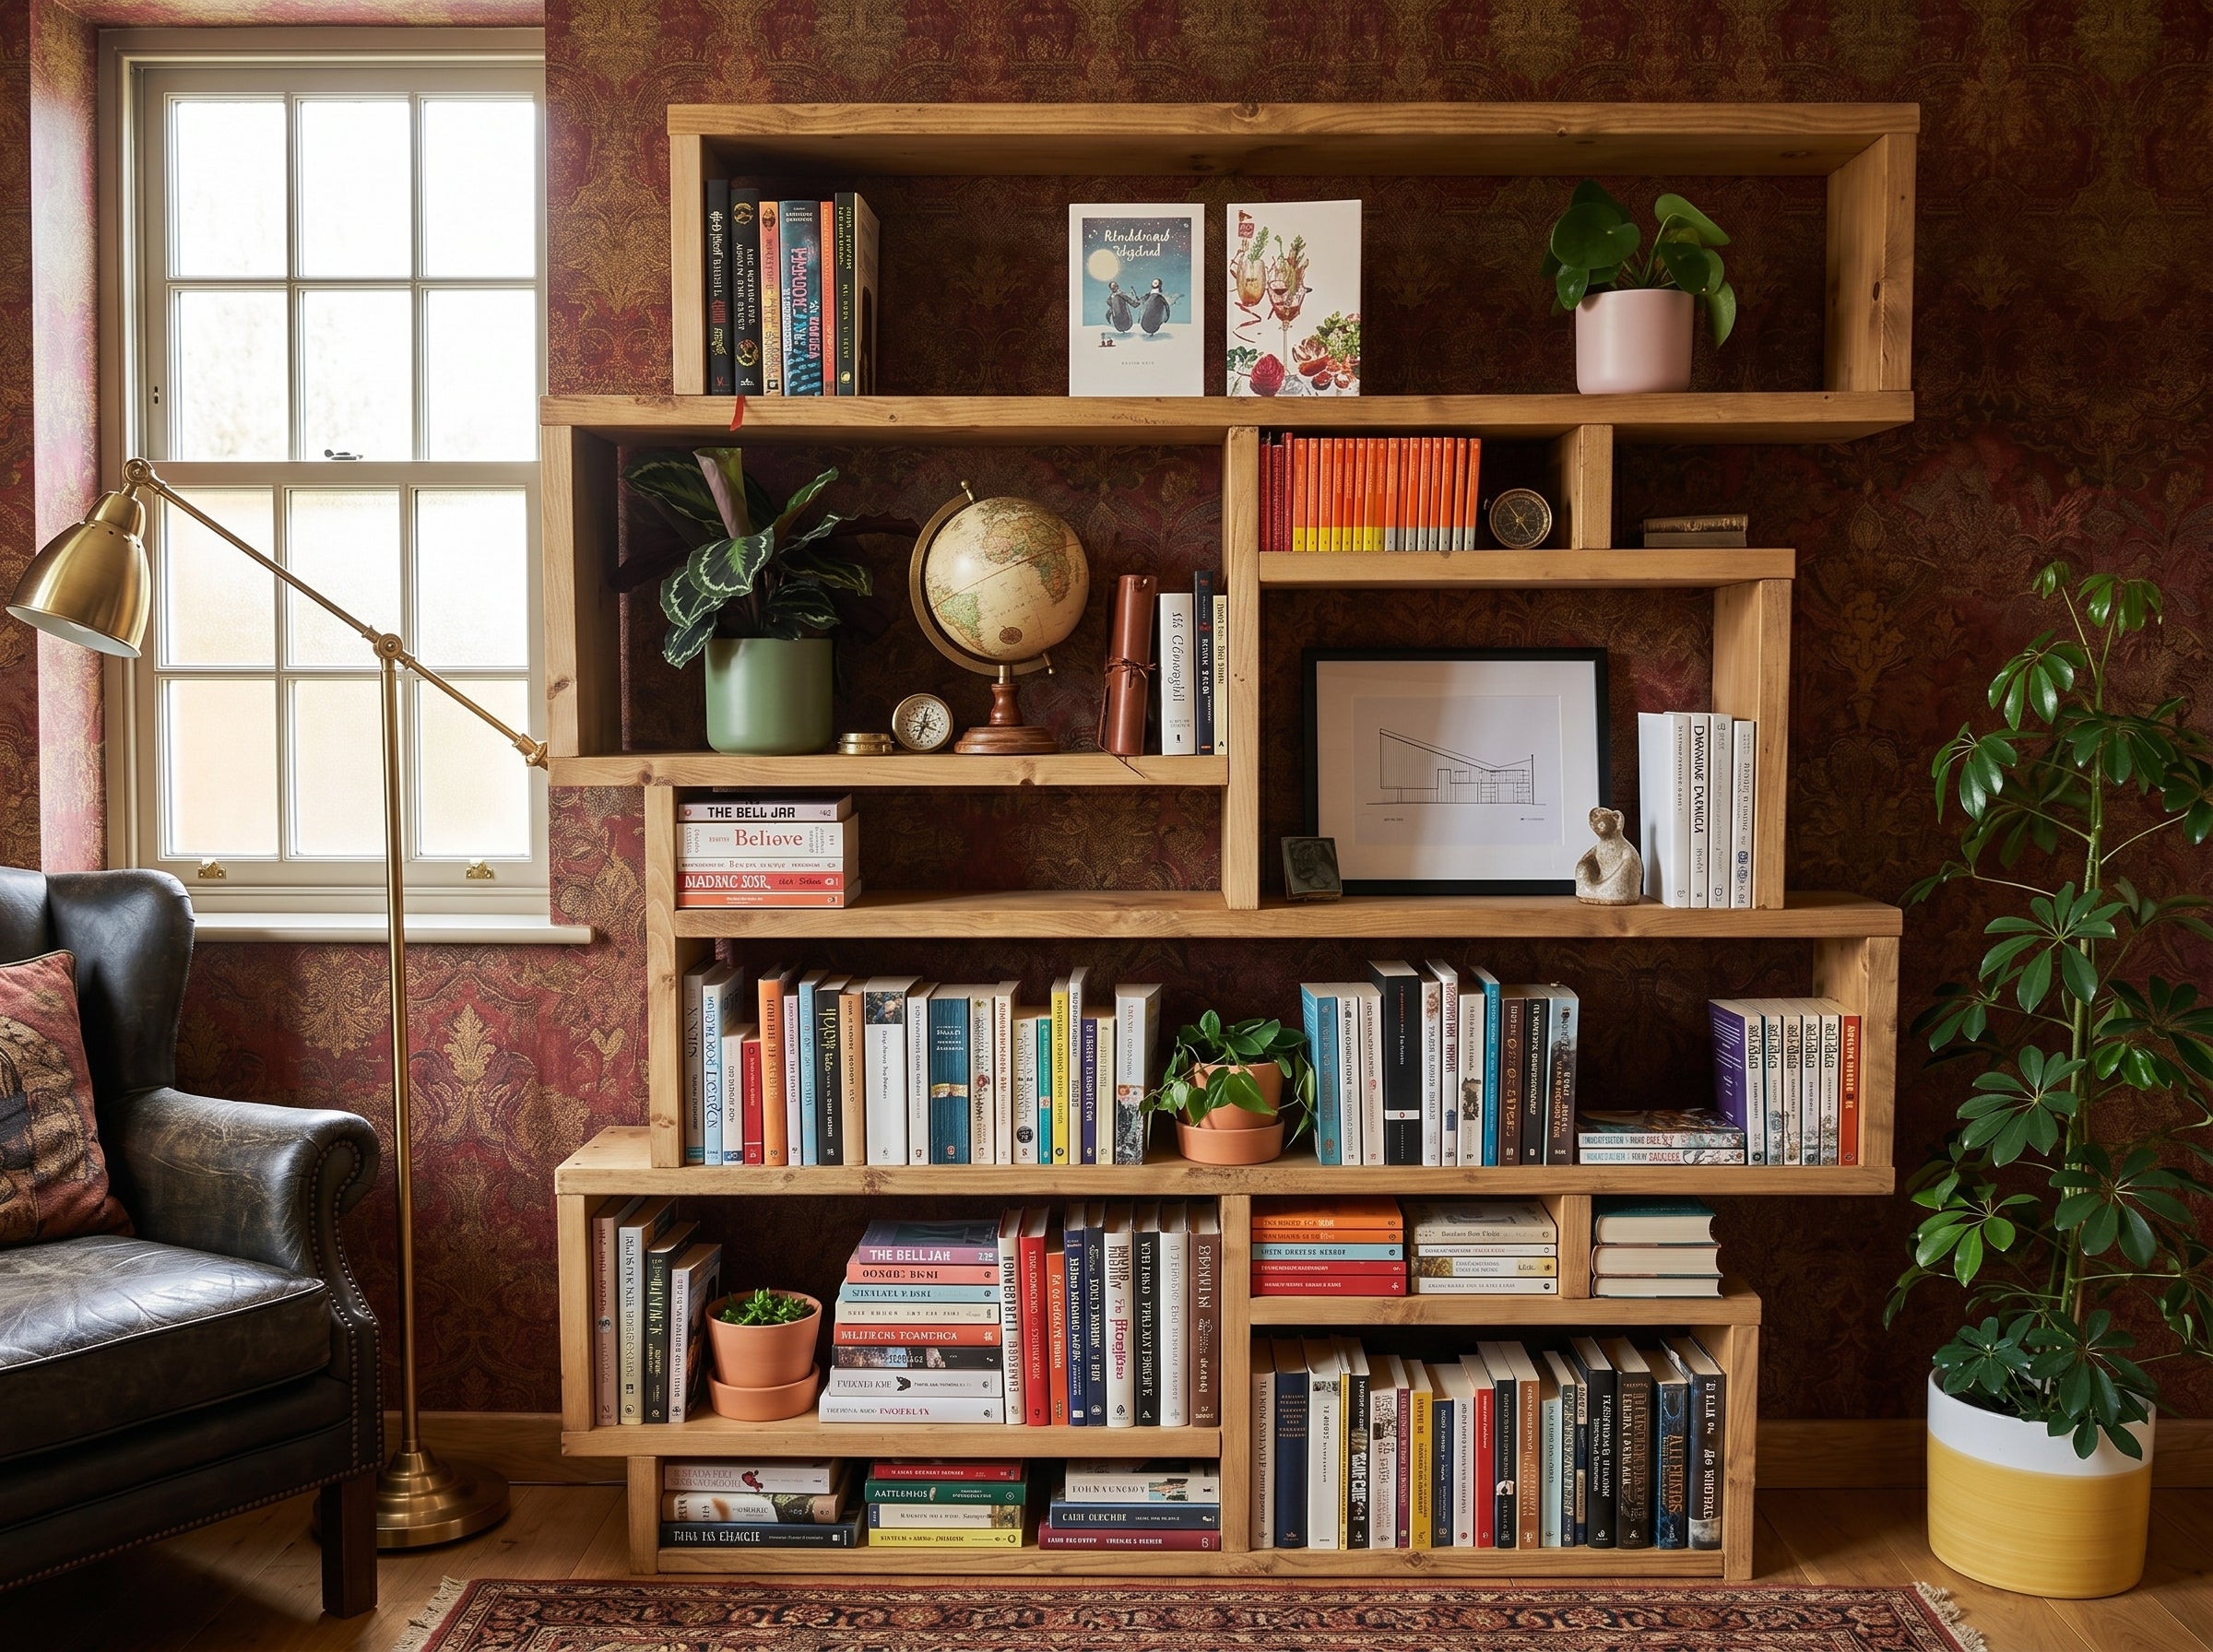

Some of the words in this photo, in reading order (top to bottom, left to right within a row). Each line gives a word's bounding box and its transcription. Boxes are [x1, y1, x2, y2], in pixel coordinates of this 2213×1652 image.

[708, 807, 732, 818] THE
[737, 807, 767, 818] BELL
[771, 807, 796, 818] JAR
[870, 1250, 893, 1261] THE
[897, 1250, 927, 1261] BELL
